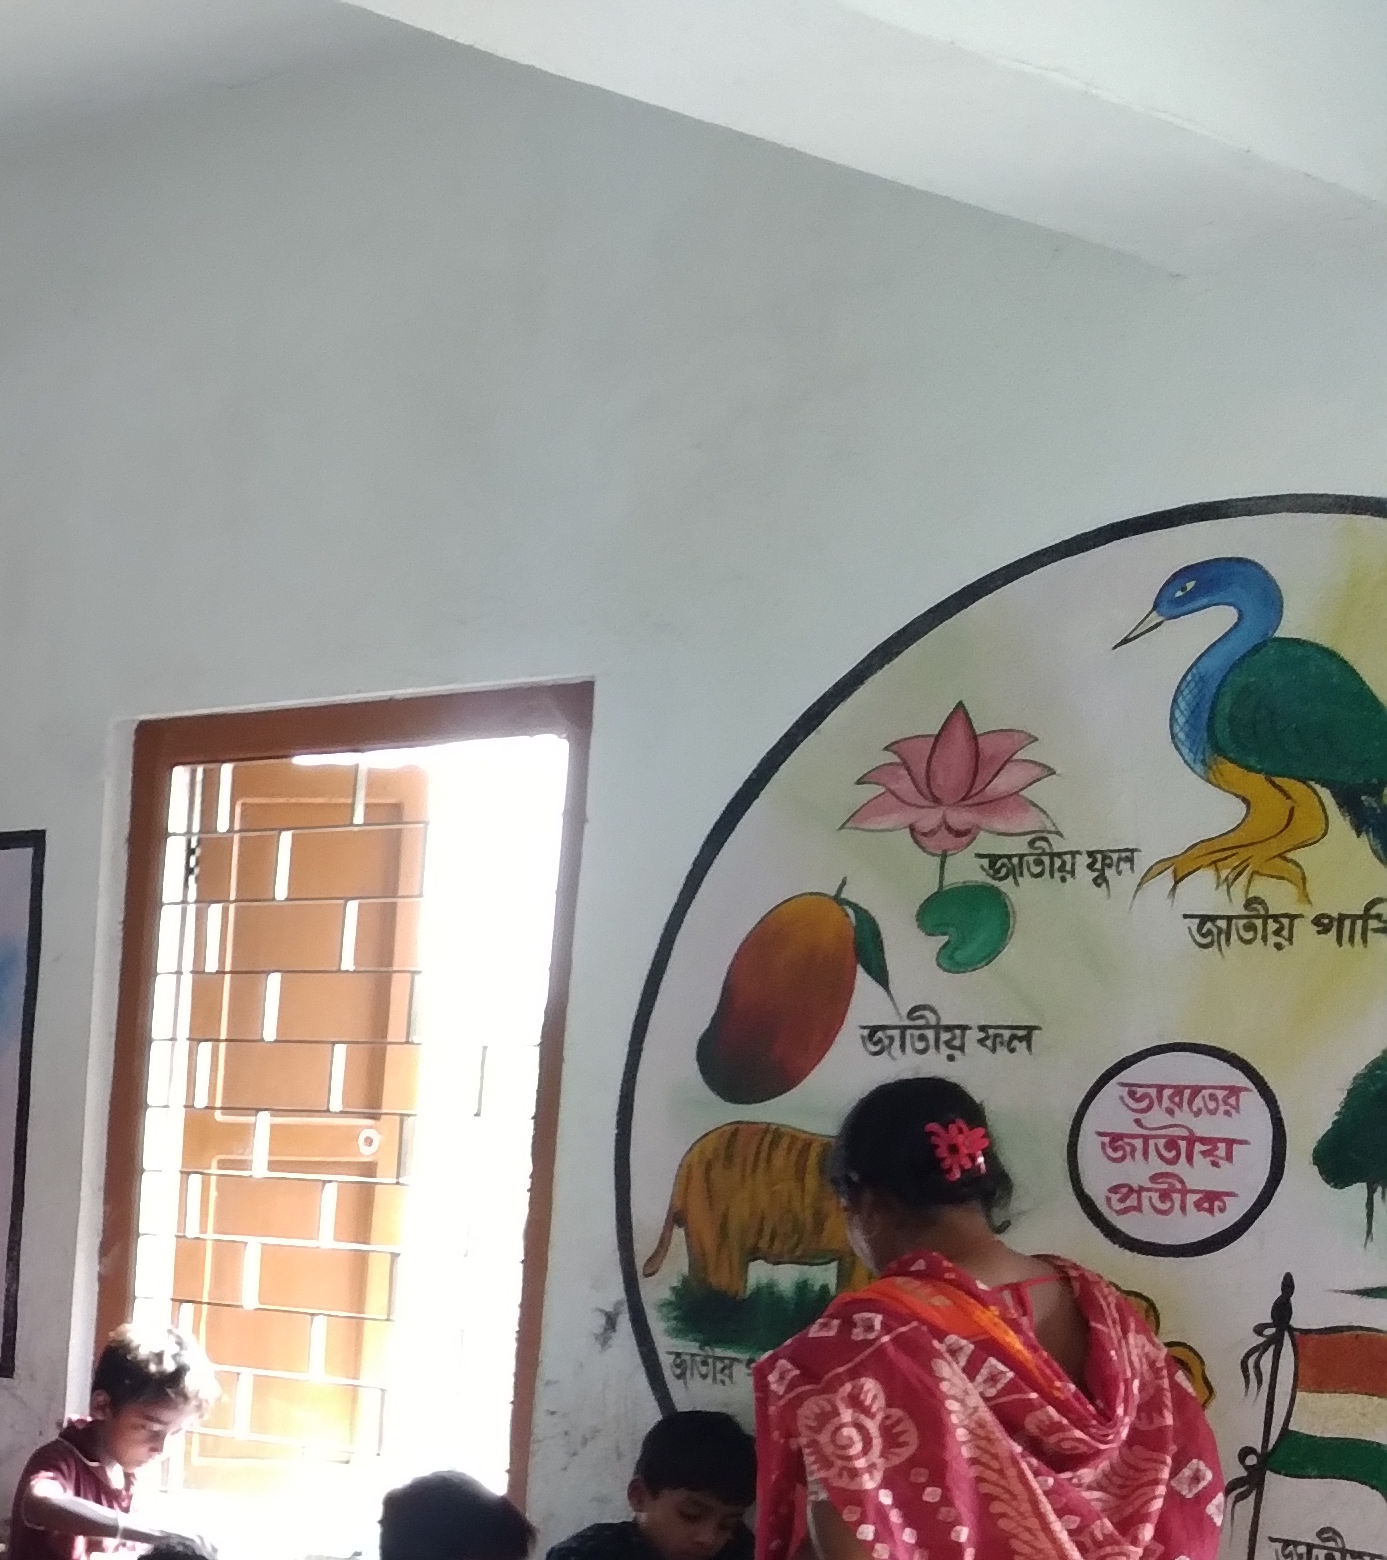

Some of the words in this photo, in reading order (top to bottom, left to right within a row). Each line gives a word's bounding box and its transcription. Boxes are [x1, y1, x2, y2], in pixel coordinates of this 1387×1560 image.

[1086, 846, 1142, 899] ফুল
[1183, 895, 1304, 960] জাতীয়
[857, 1004, 973, 1062] জাতীয়
[976, 1024, 1042, 1056] ফল
[1116, 1082, 1252, 1118] ভারতের
[1094, 1118, 1252, 1170] জাতীয়
[1104, 1170, 1239, 1218] প্রতীক
